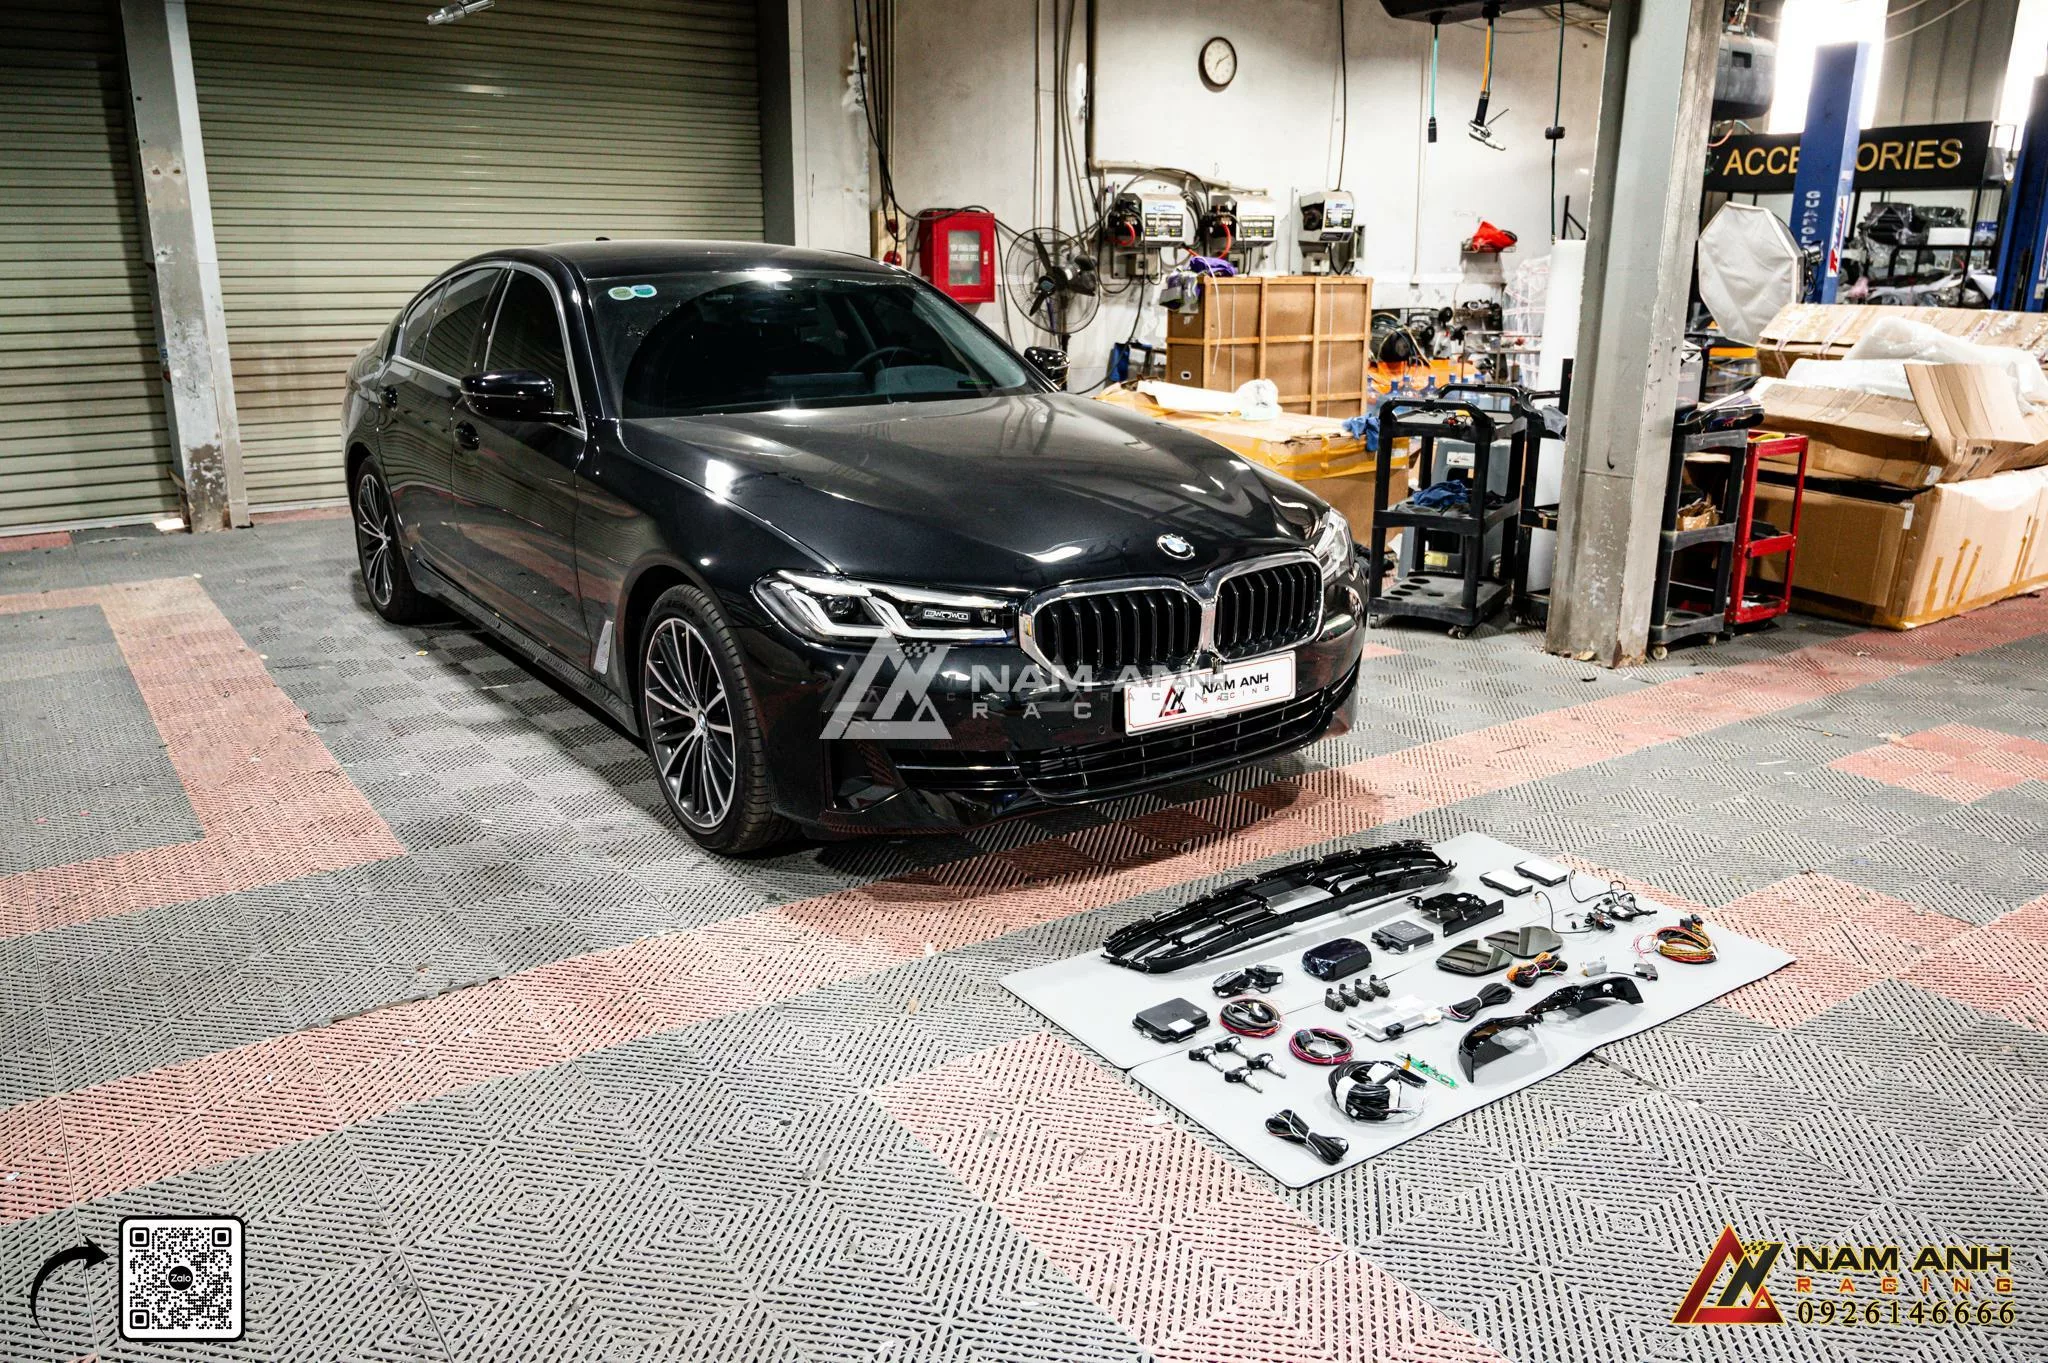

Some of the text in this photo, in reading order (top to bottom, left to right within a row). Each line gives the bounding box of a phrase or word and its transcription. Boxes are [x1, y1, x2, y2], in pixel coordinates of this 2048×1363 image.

[1723, 138, 1963, 176] ACCEORIES
[1202, 672, 1270, 695] NAM ANH
